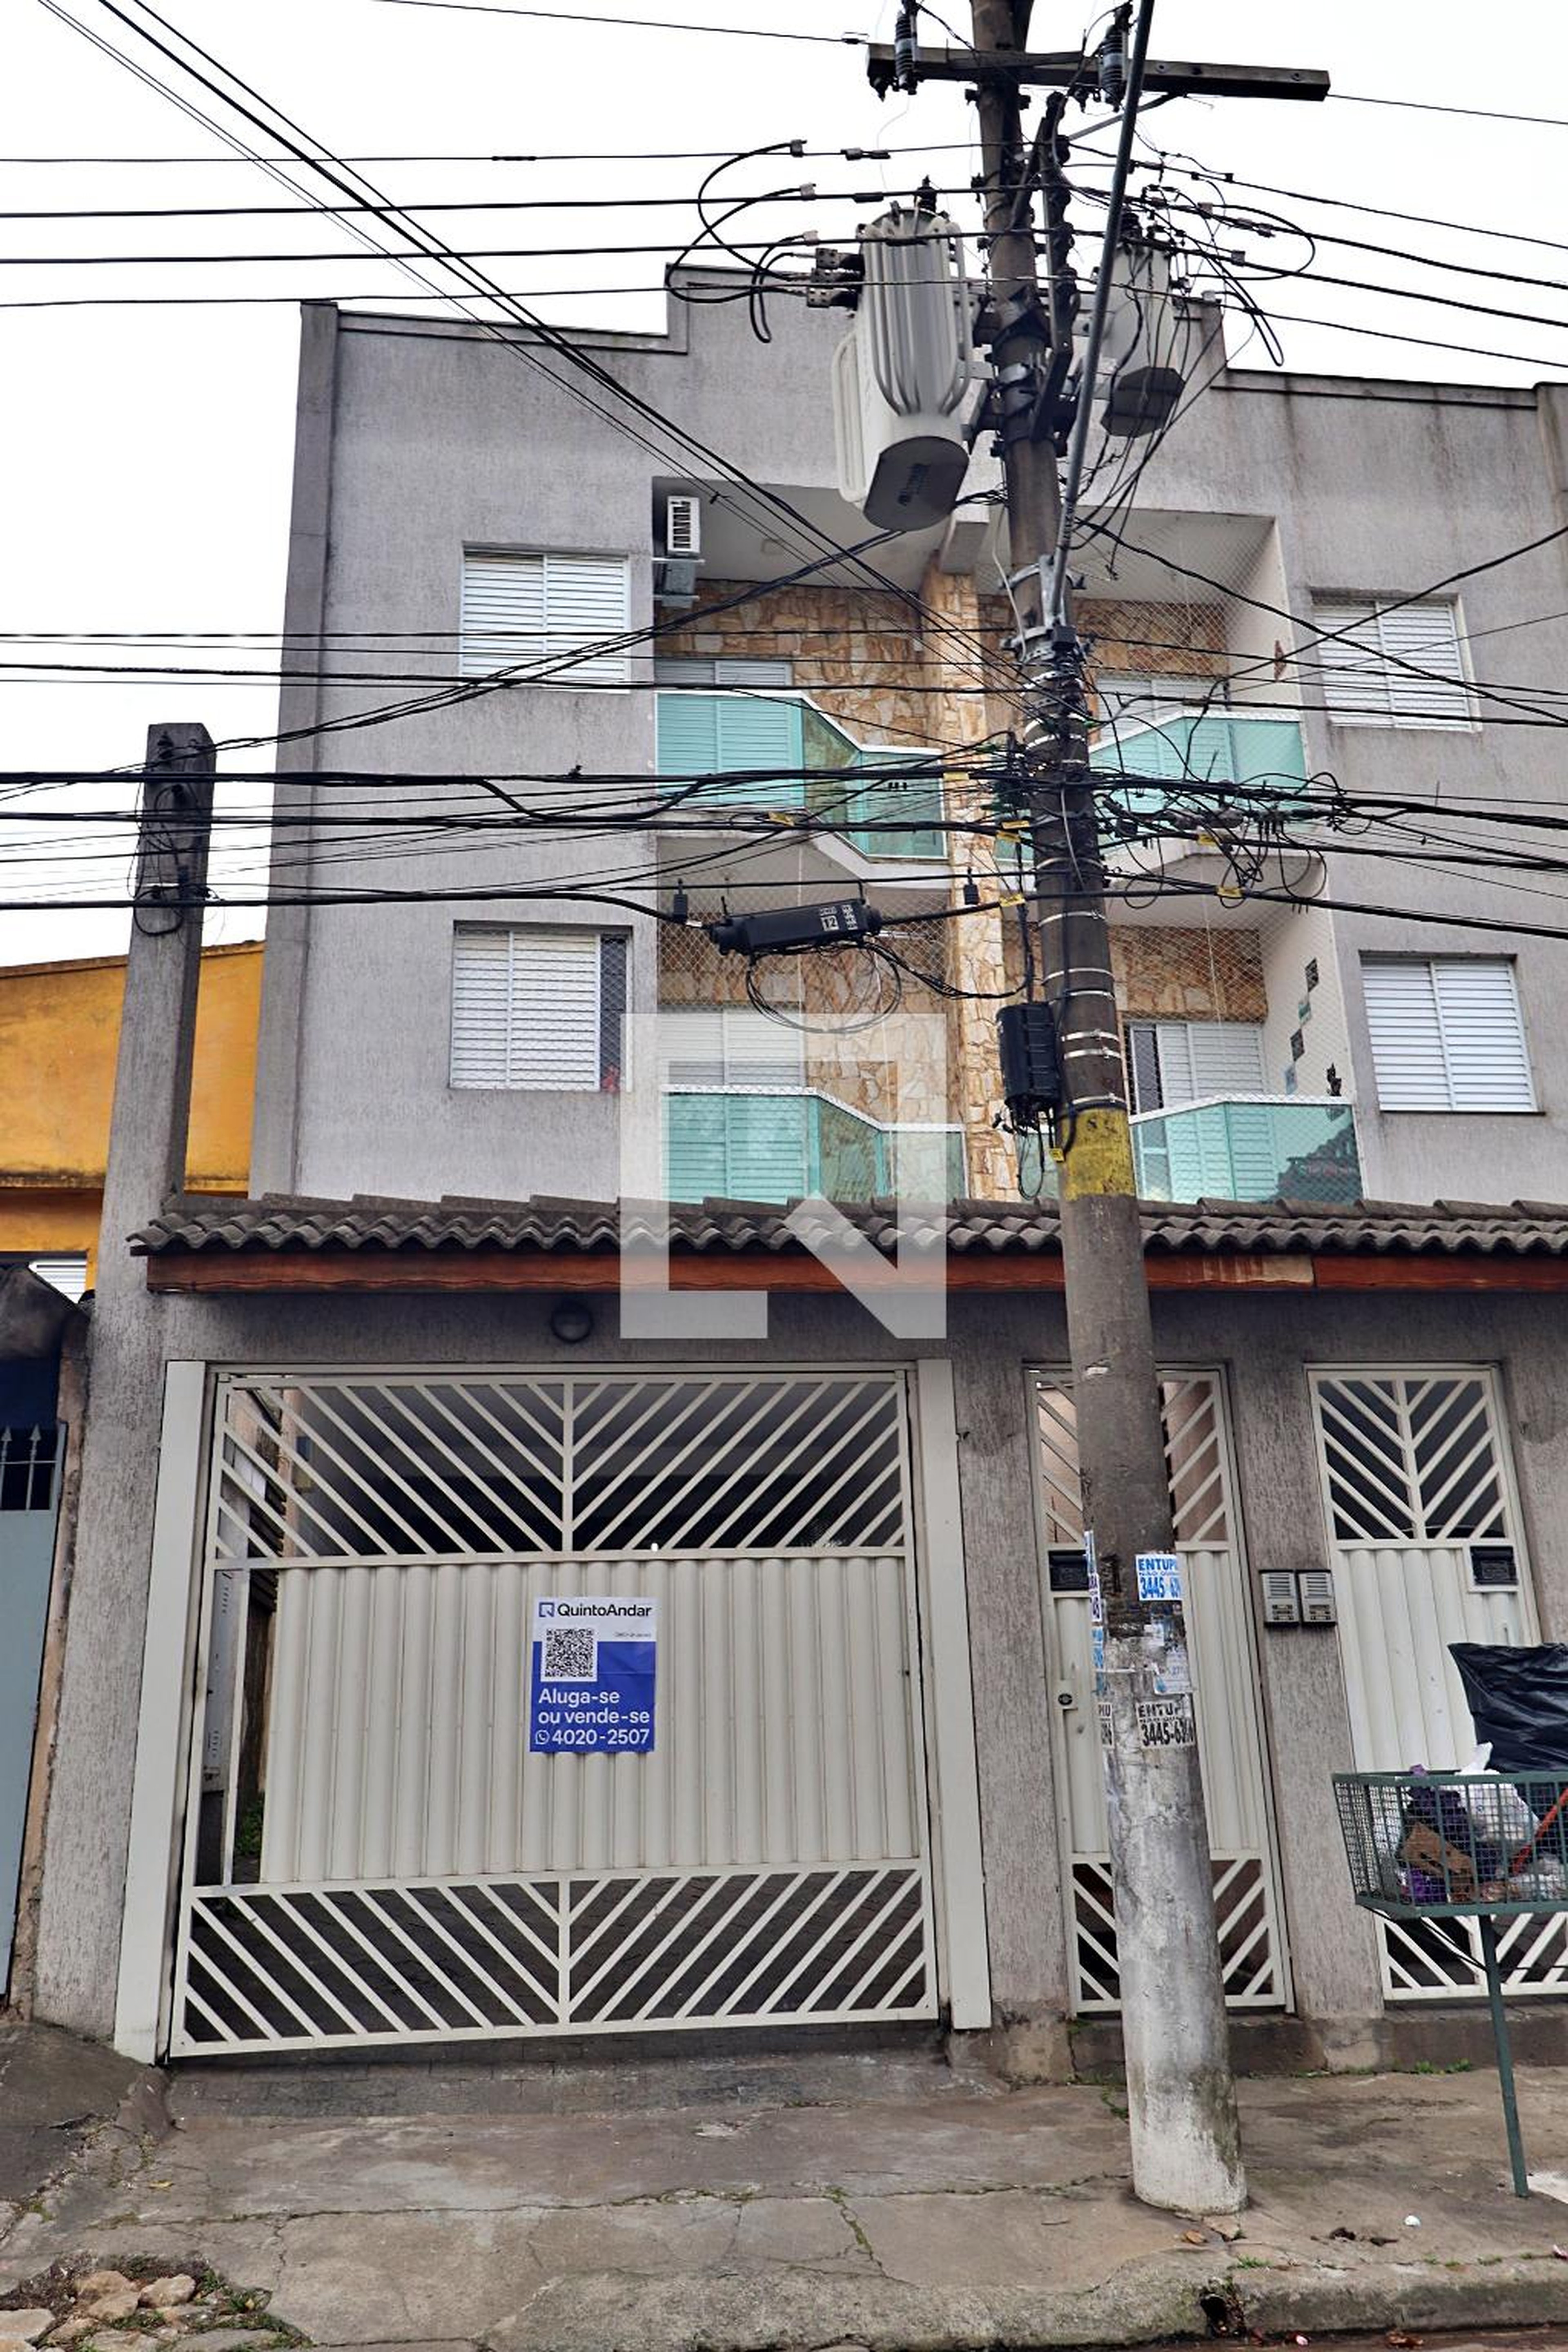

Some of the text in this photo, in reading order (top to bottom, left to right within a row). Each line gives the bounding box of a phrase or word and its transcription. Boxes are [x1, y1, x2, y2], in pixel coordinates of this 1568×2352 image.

[557, 1603, 652, 1617] QuintoAndar
[538, 1688, 620, 1708] Aluga-se
[538, 1707, 650, 1724] ou vende-se
[551, 1729, 650, 1745] 4020-2507
